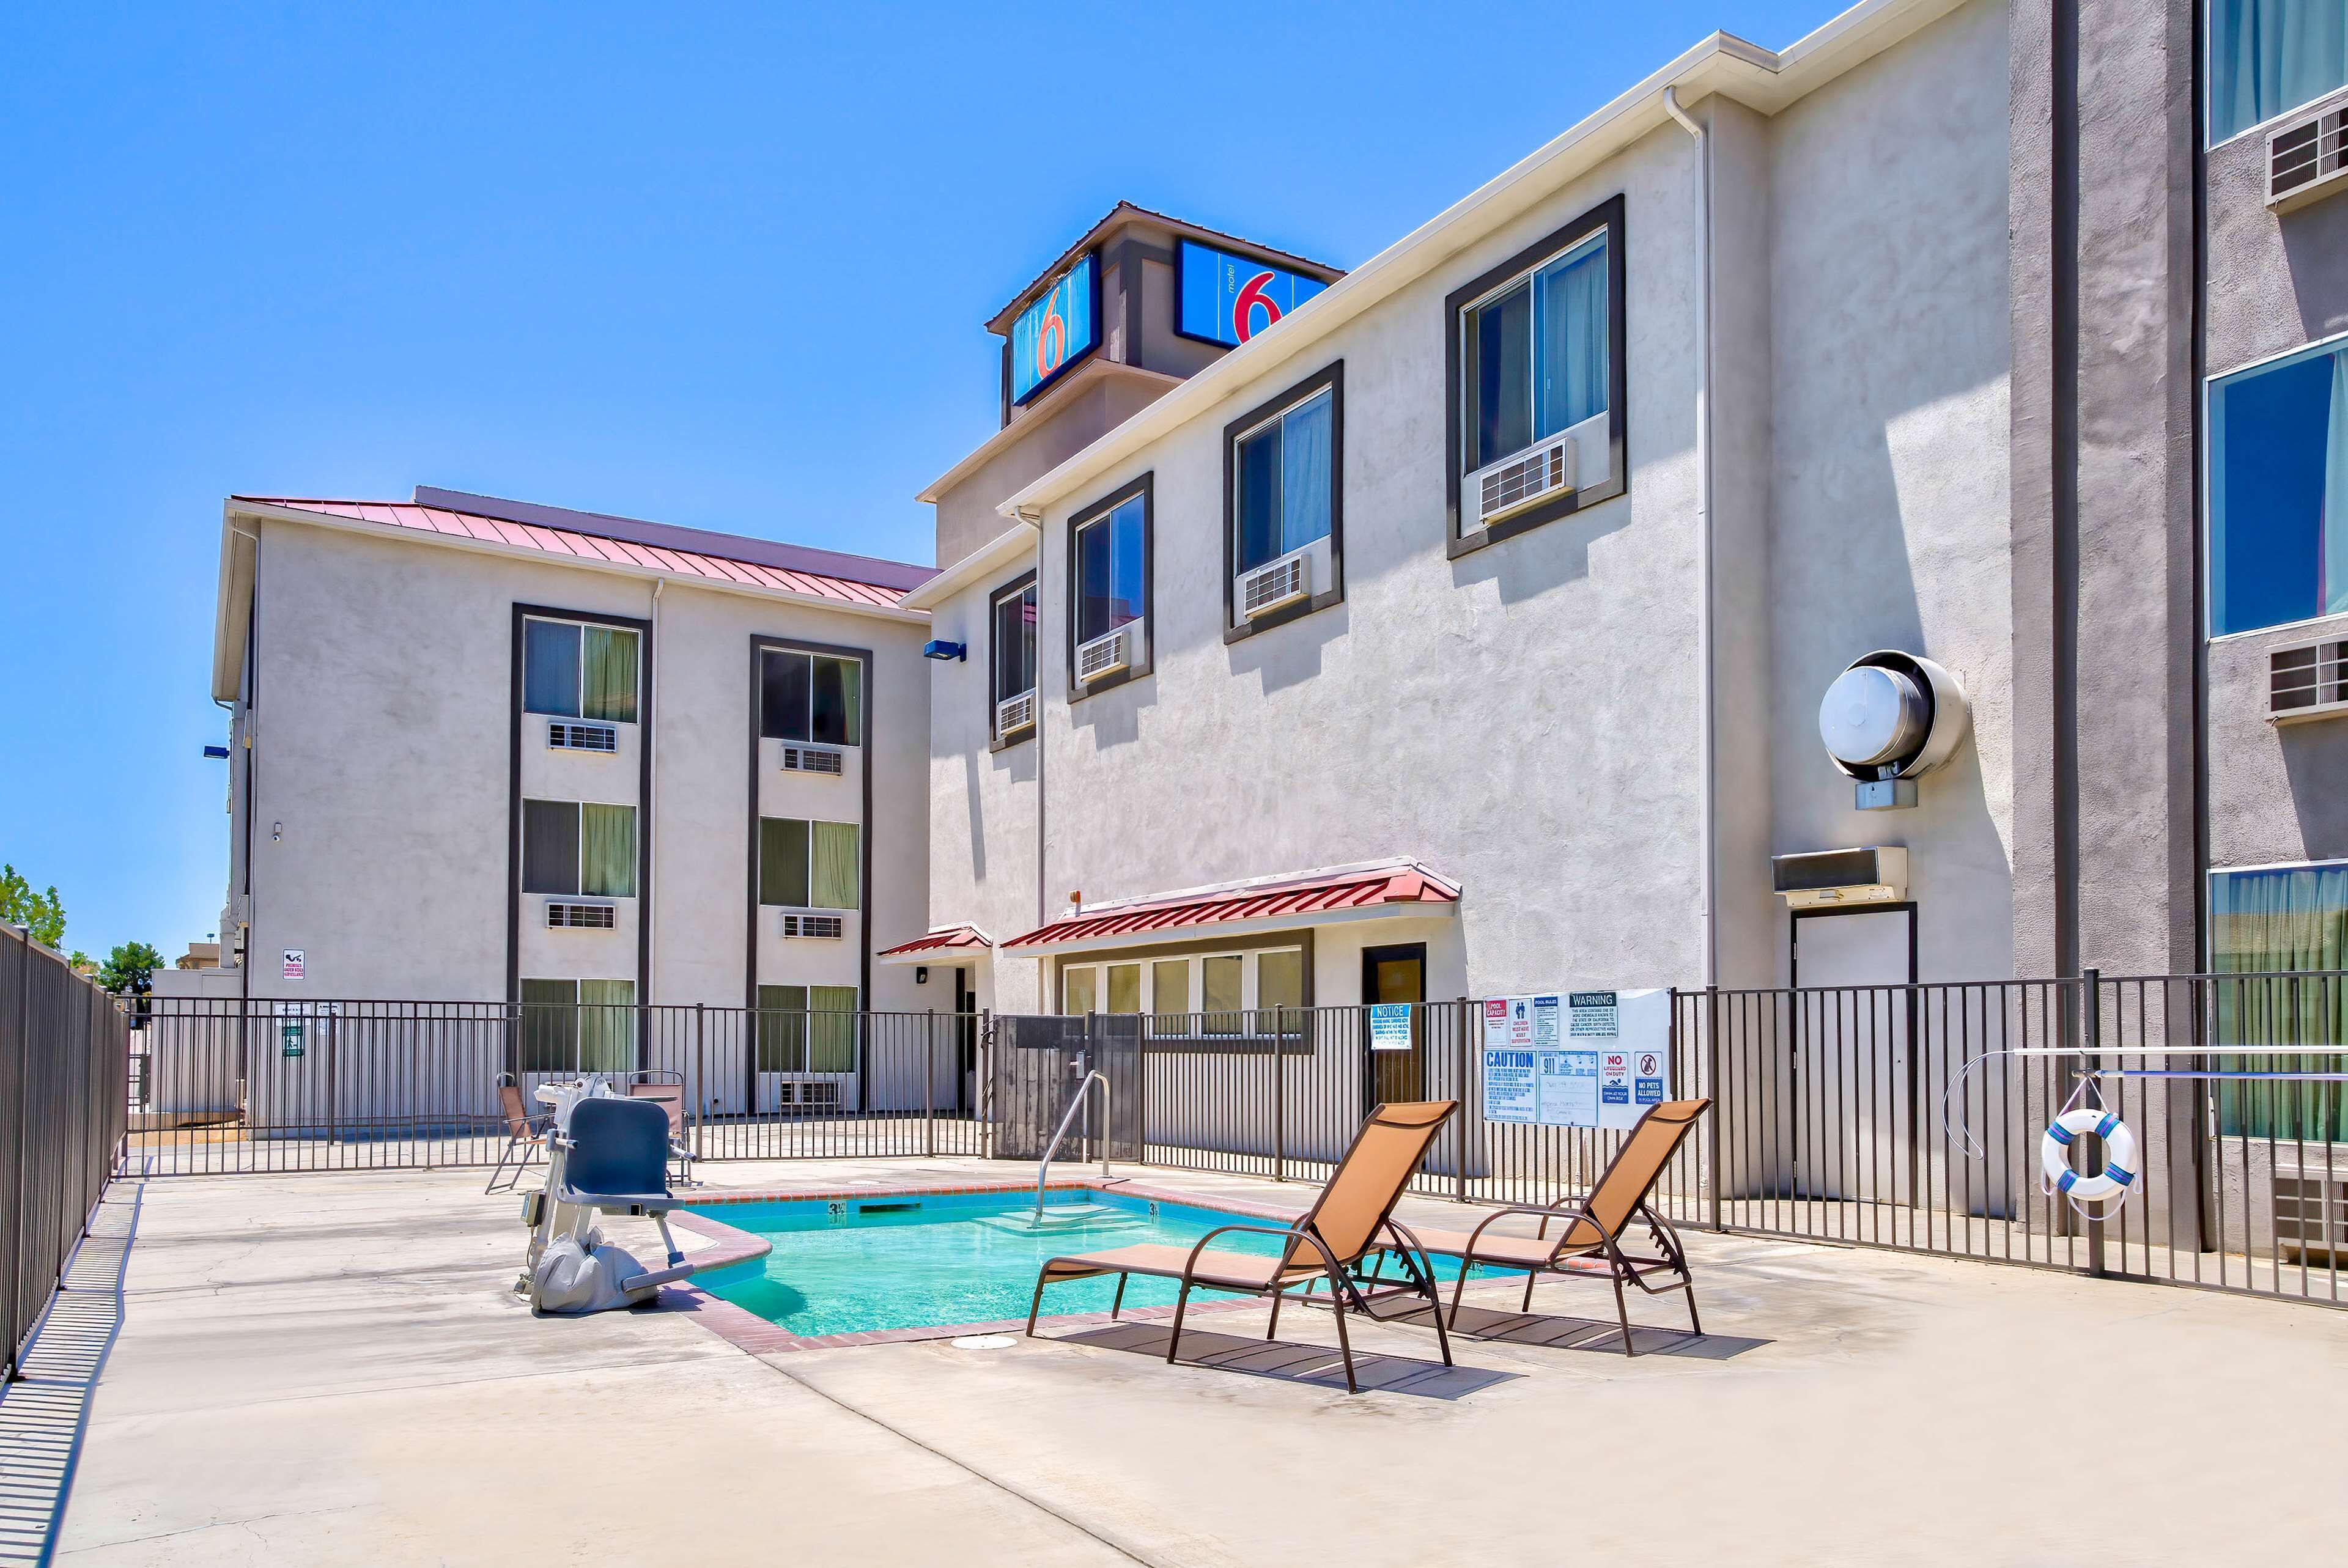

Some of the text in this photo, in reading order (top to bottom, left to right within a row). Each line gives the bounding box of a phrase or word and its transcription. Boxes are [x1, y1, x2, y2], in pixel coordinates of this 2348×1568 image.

[1233, 271, 1282, 344] 6
[1037, 286, 1065, 380] 6
[1573, 995, 1612, 1006] WARNING
[1377, 1006, 1403, 1017] NOTICE
[1487, 1052, 1534, 1067] CAUTION
[1544, 1058, 1554, 1074] 911
[1608, 1056, 1622, 1065] NO
